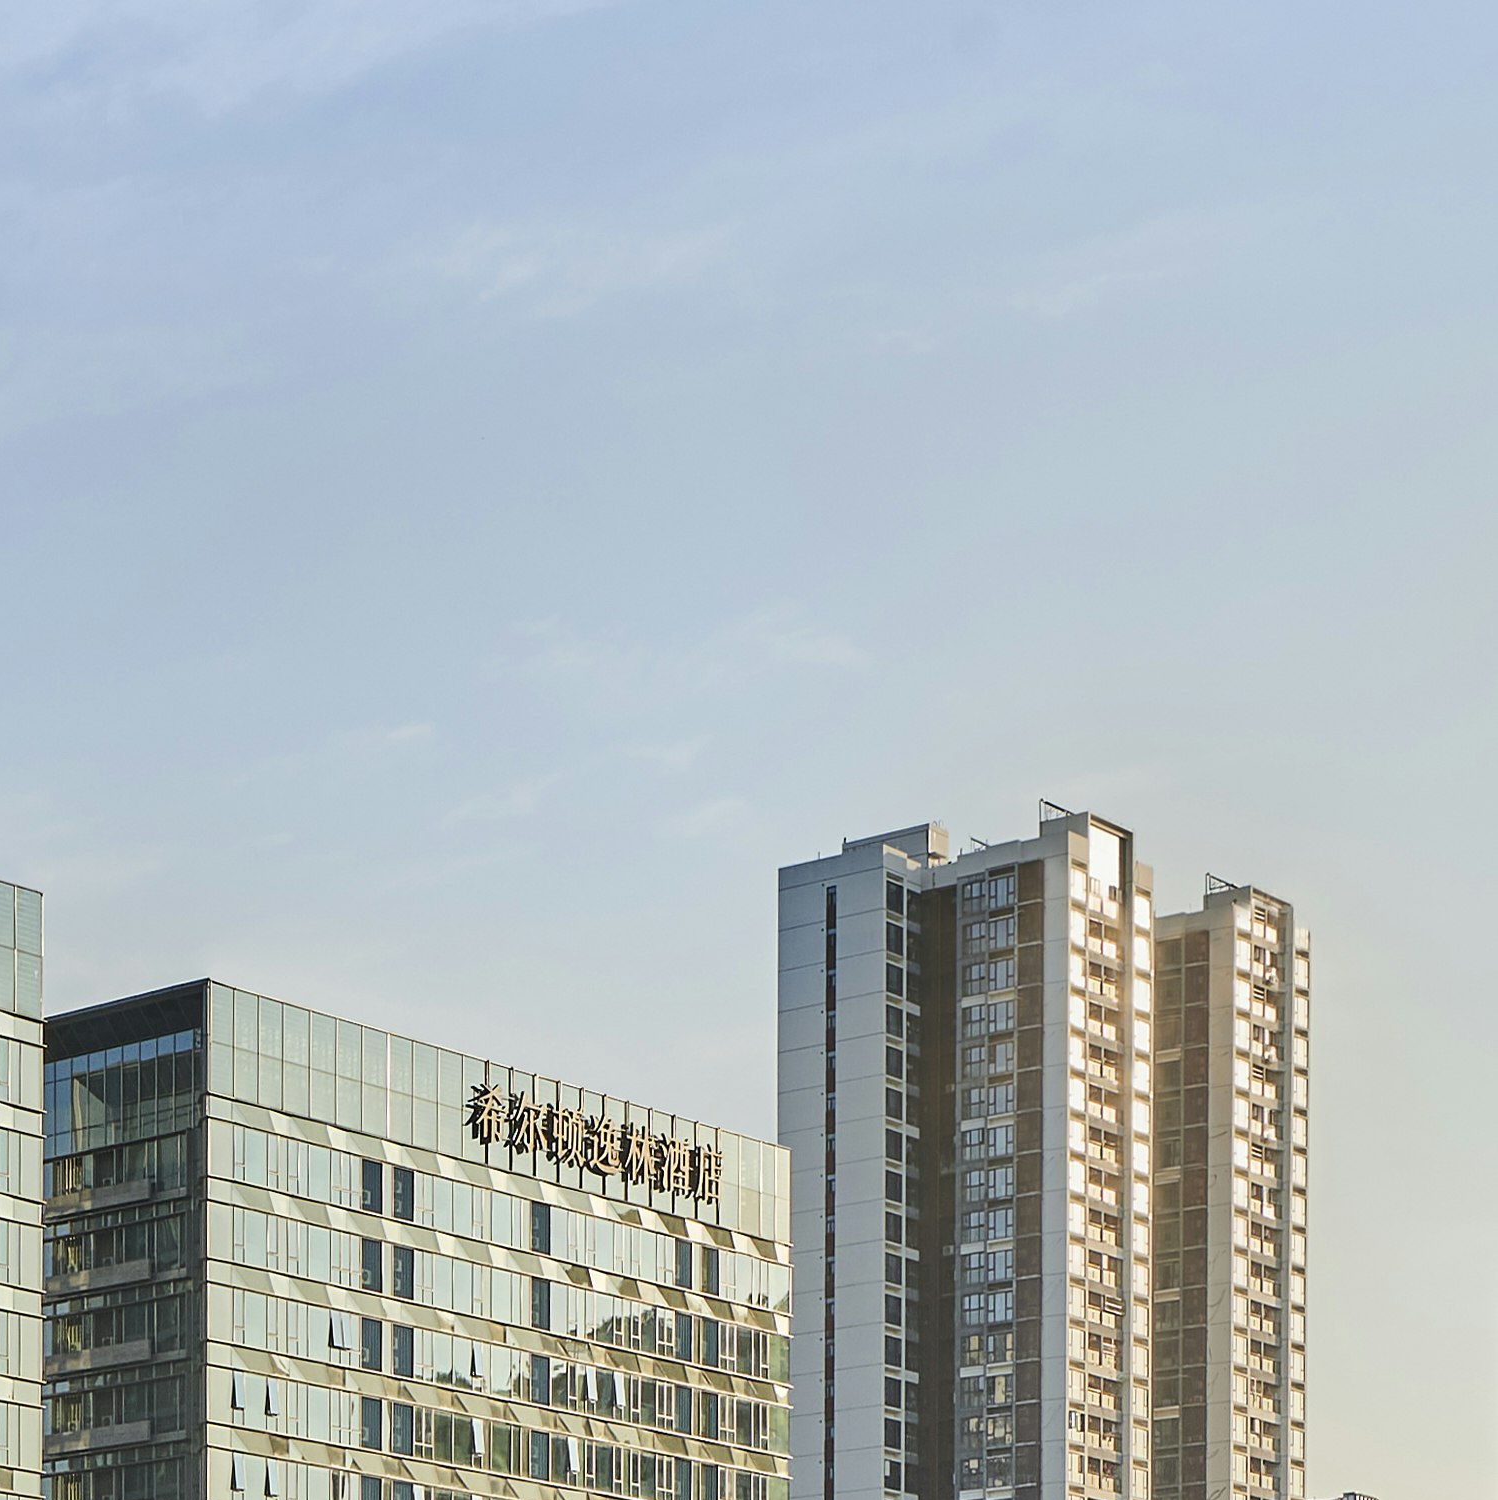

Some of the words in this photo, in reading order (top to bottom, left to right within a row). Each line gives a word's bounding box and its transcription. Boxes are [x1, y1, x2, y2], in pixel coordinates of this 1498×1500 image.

[464, 1083, 724, 1204] 希尔顿逸林酒店
